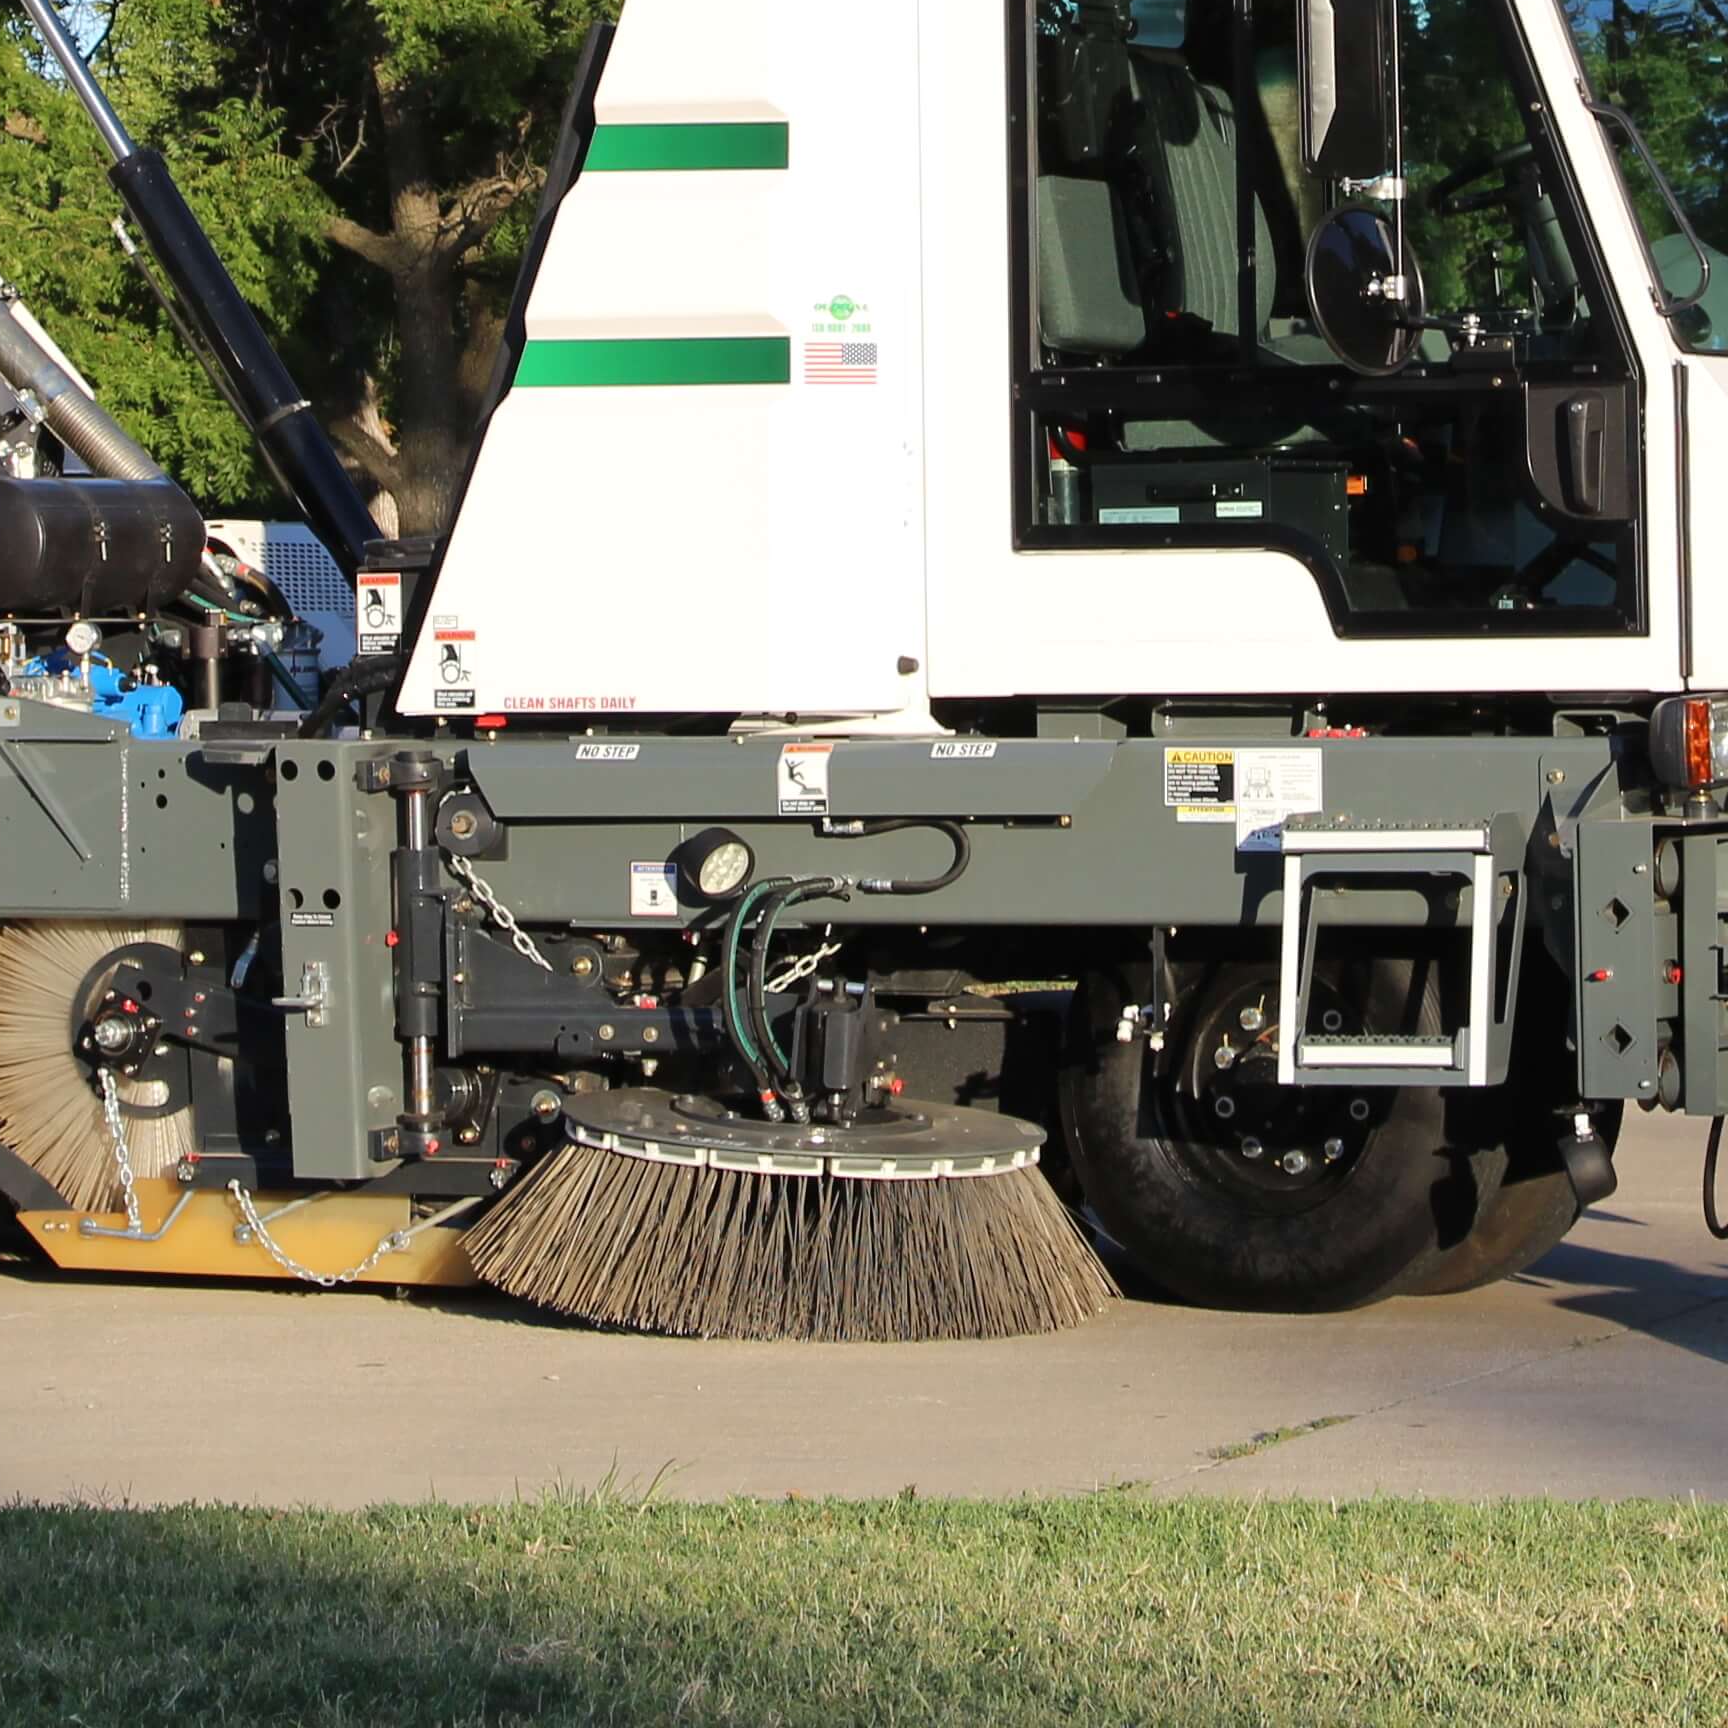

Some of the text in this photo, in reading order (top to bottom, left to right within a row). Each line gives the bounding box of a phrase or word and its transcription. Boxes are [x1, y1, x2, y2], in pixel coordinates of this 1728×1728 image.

[503, 696, 638, 710] CLEAN SHAFTS DAILY
[579, 746, 636, 758] NO STEP
[935, 743, 993, 756] NO STEP
[1183, 751, 1233, 761] CAUTION
